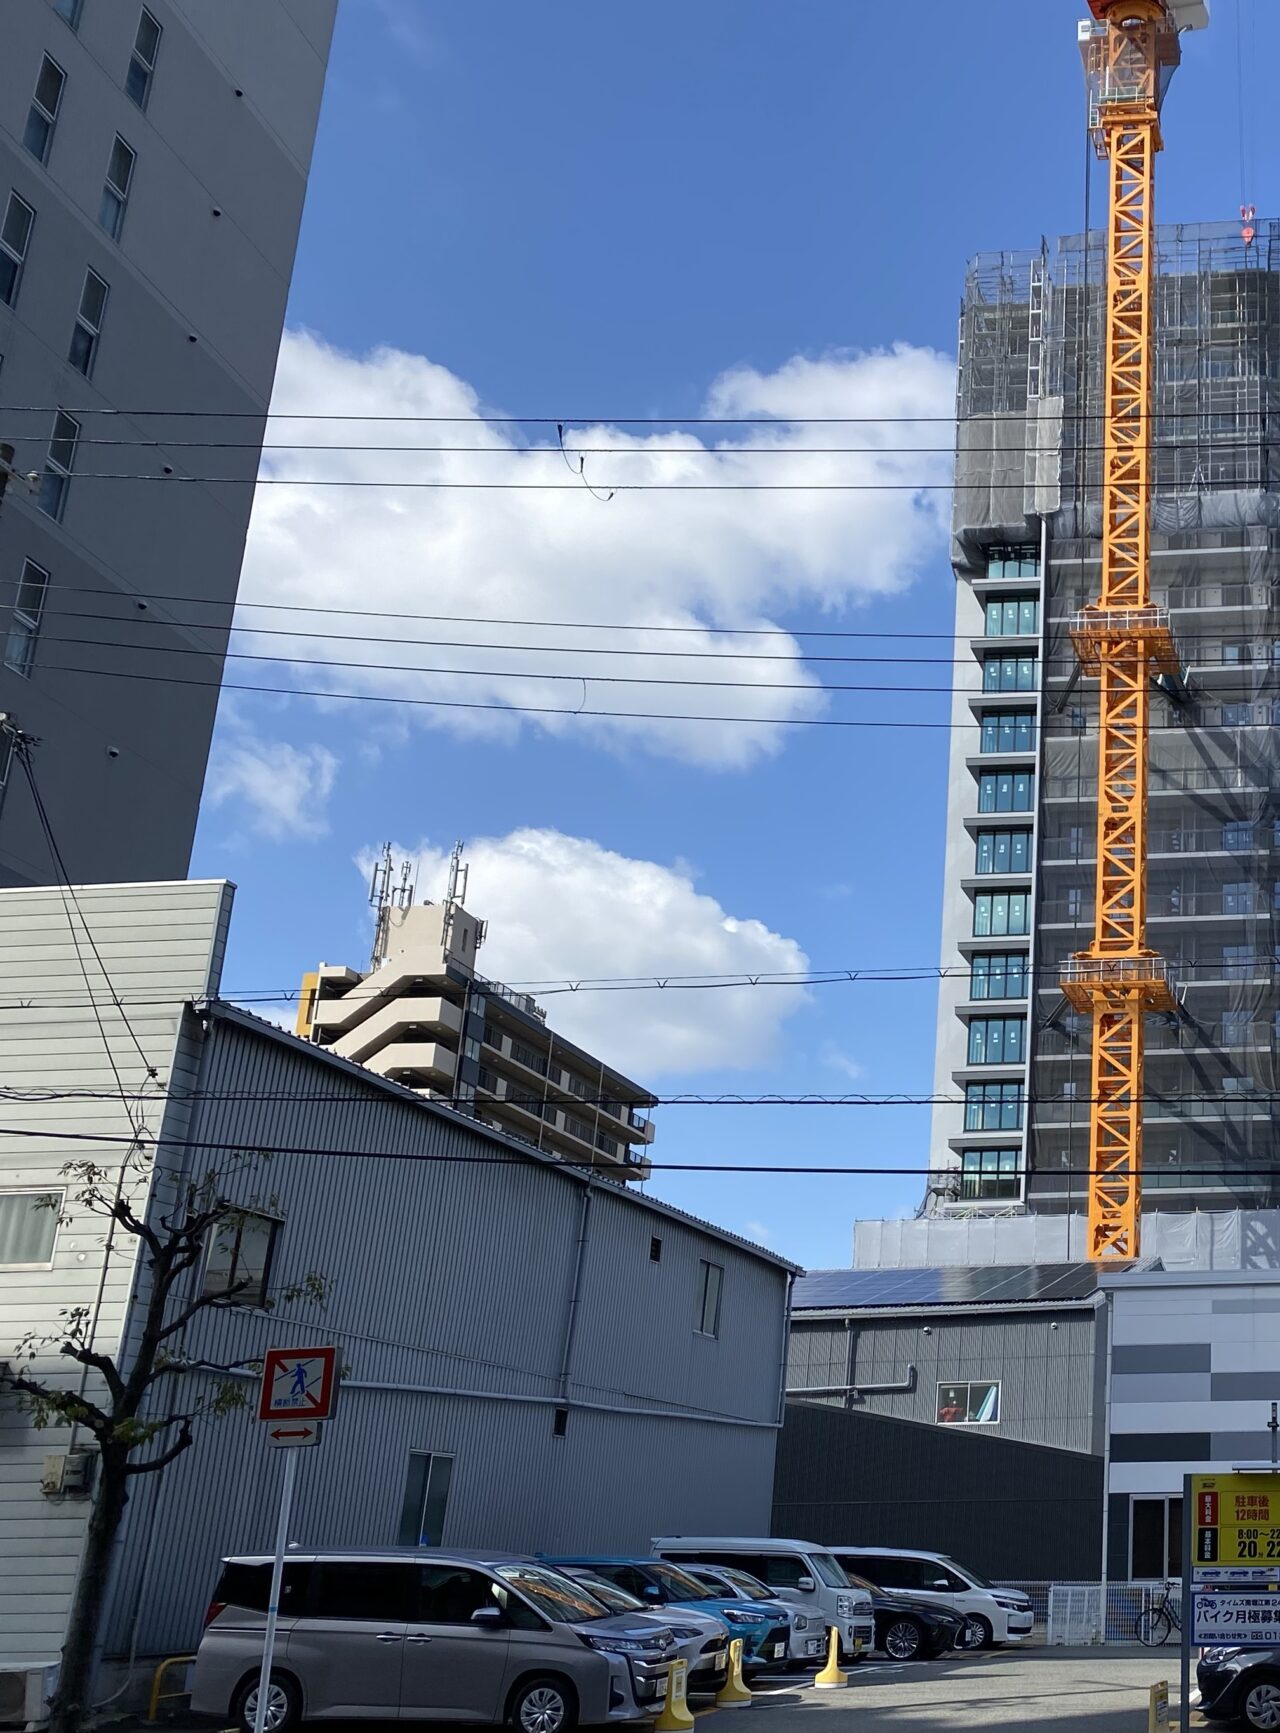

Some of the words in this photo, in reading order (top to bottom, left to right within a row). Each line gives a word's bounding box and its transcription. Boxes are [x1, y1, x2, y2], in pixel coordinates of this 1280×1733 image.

[1235, 1495, 1270, 1507] 駐車後
[1235, 1509, 1270, 1521] 12時間
